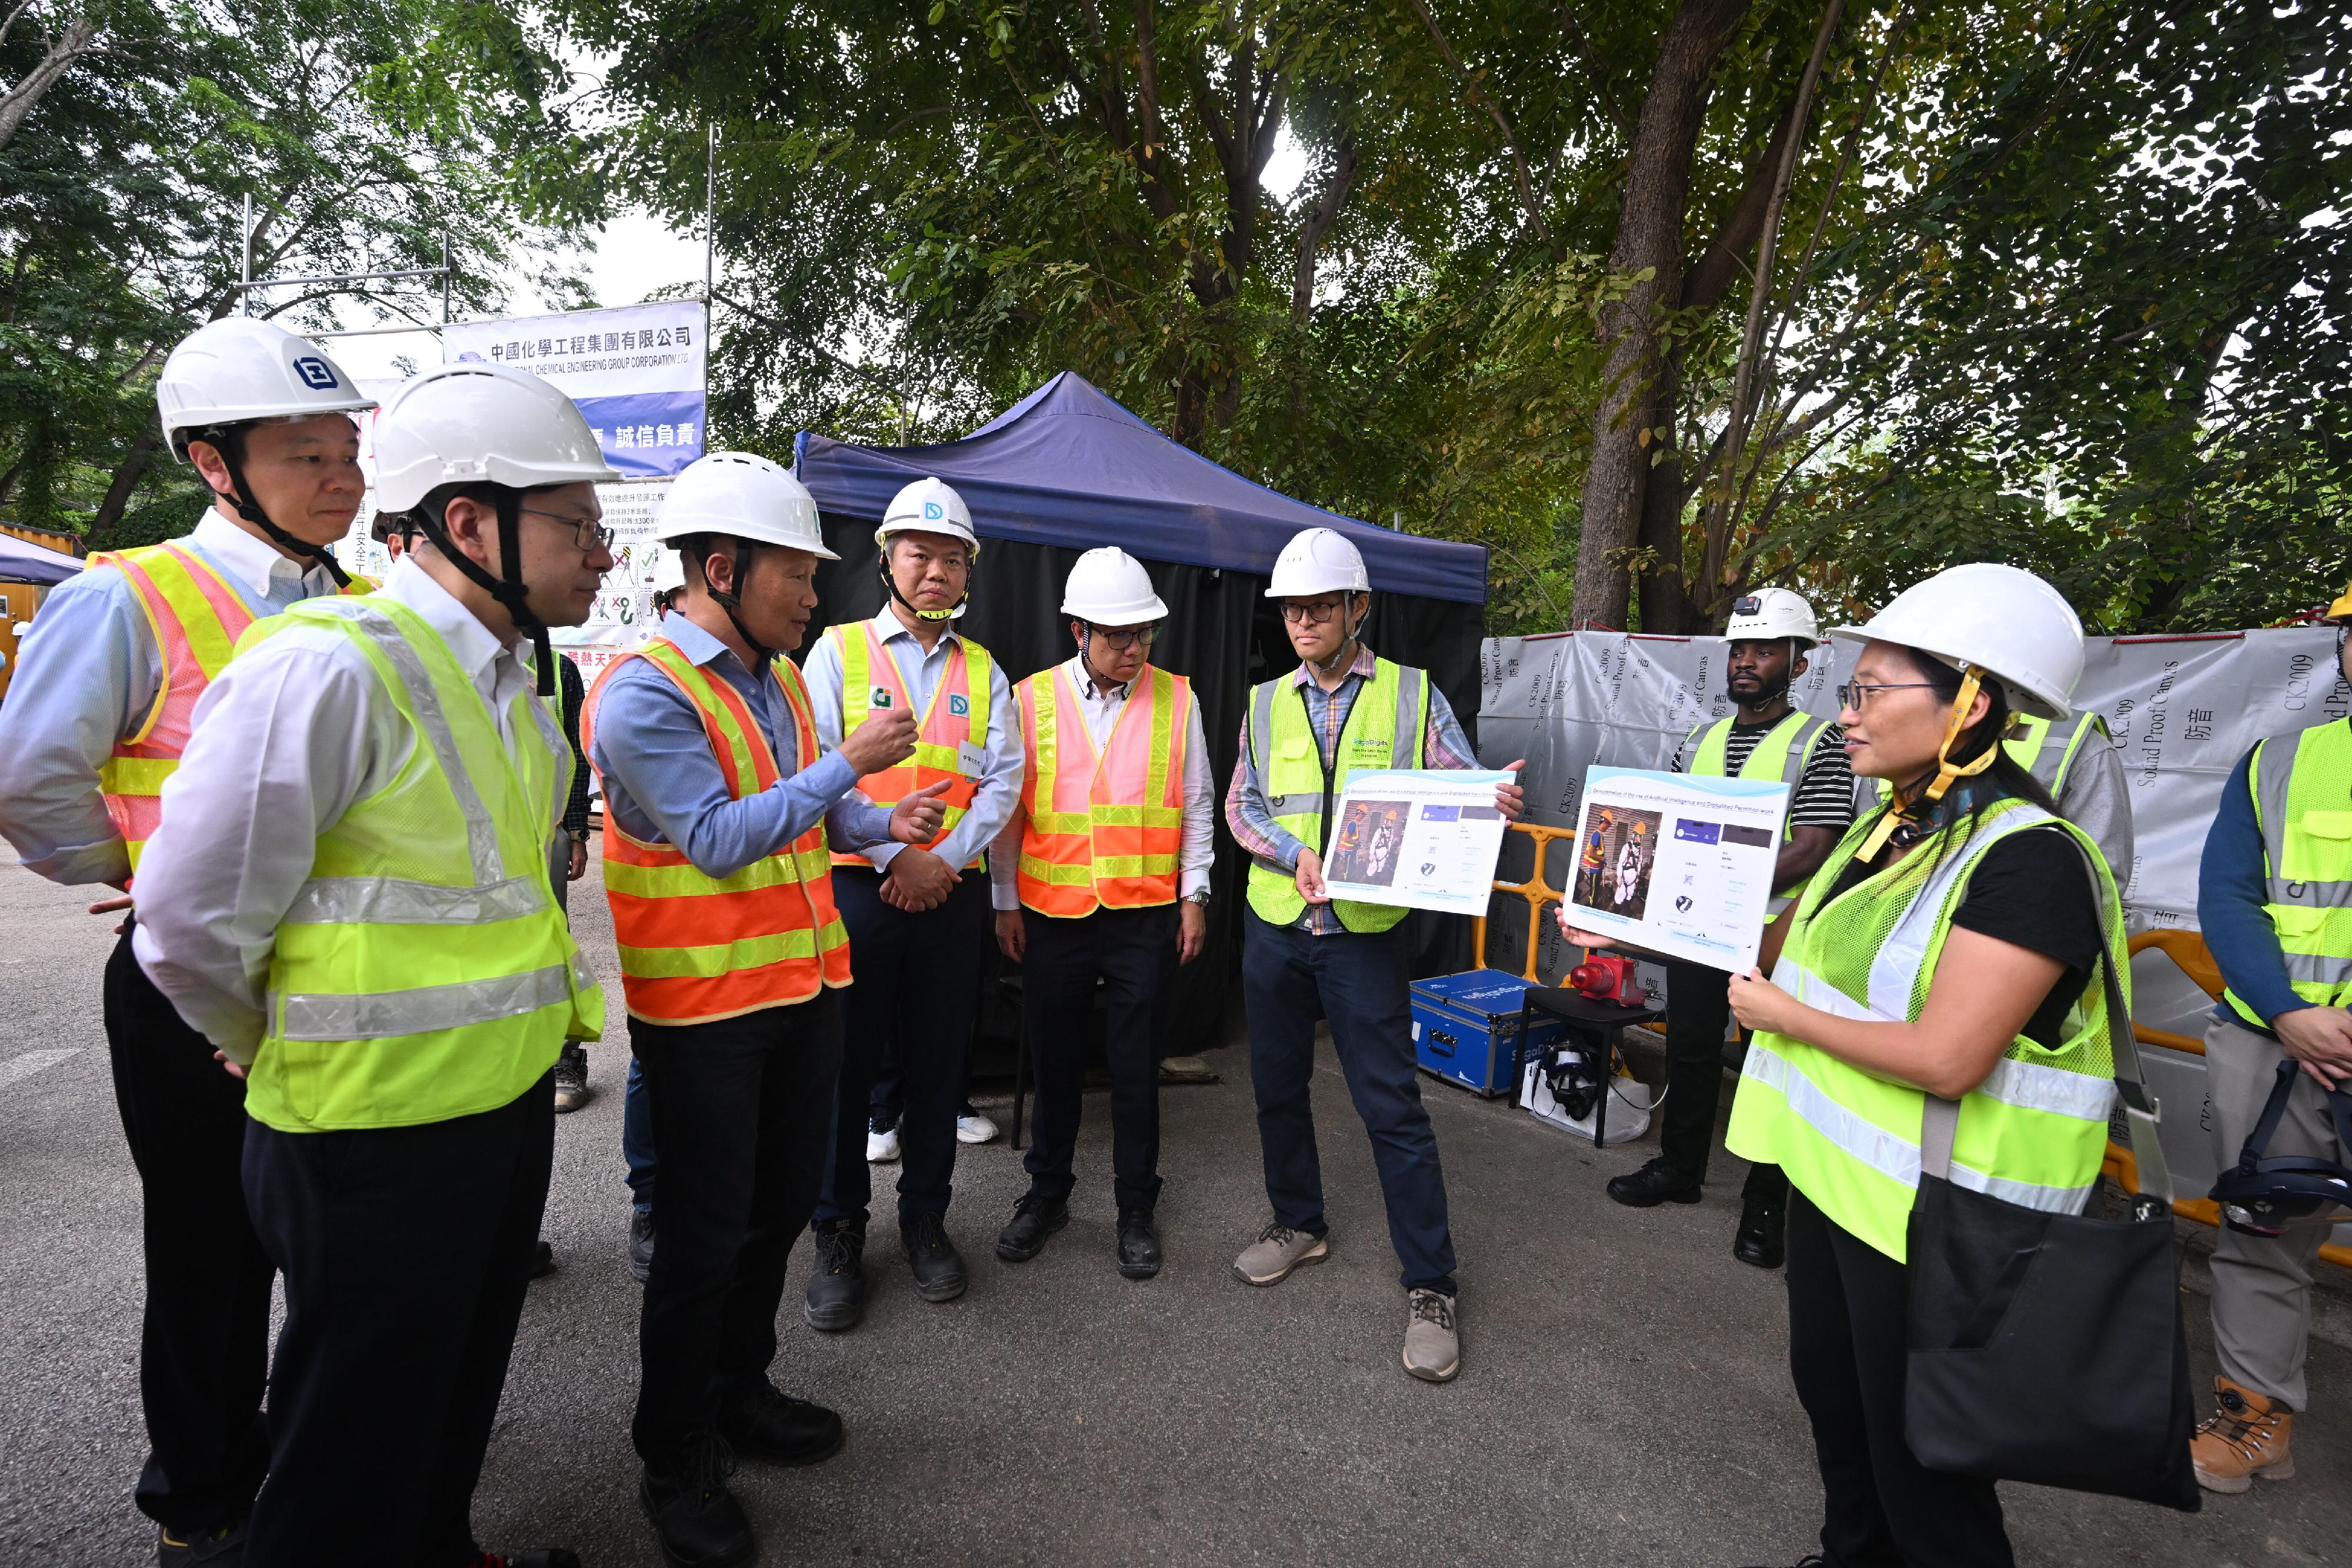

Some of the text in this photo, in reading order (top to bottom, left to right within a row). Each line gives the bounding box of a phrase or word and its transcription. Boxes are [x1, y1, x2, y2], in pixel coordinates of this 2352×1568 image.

[491, 326, 691, 362] 中國化學工程集團有限公司
[536, 363, 565, 376] CHEMICAL
[567, 360, 607, 373] ENGINEERING
[608, 358, 630, 370] GROUP
[631, 354, 676, 369] CORPORATION
[615, 422, 695, 449] 誠信負責
[1481, 653, 1489, 685] CK2009
[1492, 659, 1502, 680] Proof
[1508, 658, 1519, 677] 防音
[1595, 648, 1611, 684] CK2009
[1632, 658, 1649, 679] 防音
[1695, 656, 1709, 690] Canvas
[1808, 666, 1826, 690] 防音
[1489, 682, 1502, 706] Sound
[1529, 674, 1542, 707] CK2009
[1553, 680, 1568, 700] 防音
[1605, 684, 1621, 710] Sound
[1613, 656, 1626, 682] Proof
[2284, 654, 2314, 711] CK2009
[1534, 706, 1546, 730] Sound
[1541, 679, 1552, 703] Proof
[1669, 683, 1688, 720] CK2009
[1688, 690, 1705, 717] Proof
[1712, 693, 1728, 717] 防音
[2111, 699, 2135, 749] CK2009
[2137, 661, 2179, 788] Sound Proof Canvas
[2184, 708, 2214, 740] 防音
[1559, 777, 1578, 814] CK2009
[1593, 788, 1622, 796] Demonstration
[1669, 796, 1696, 805] Intelligence
[1734, 804, 1774, 815] Permit-to-work
[1538, 910, 1548, 946] CK2009
[1544, 947, 1559, 975] Sound
